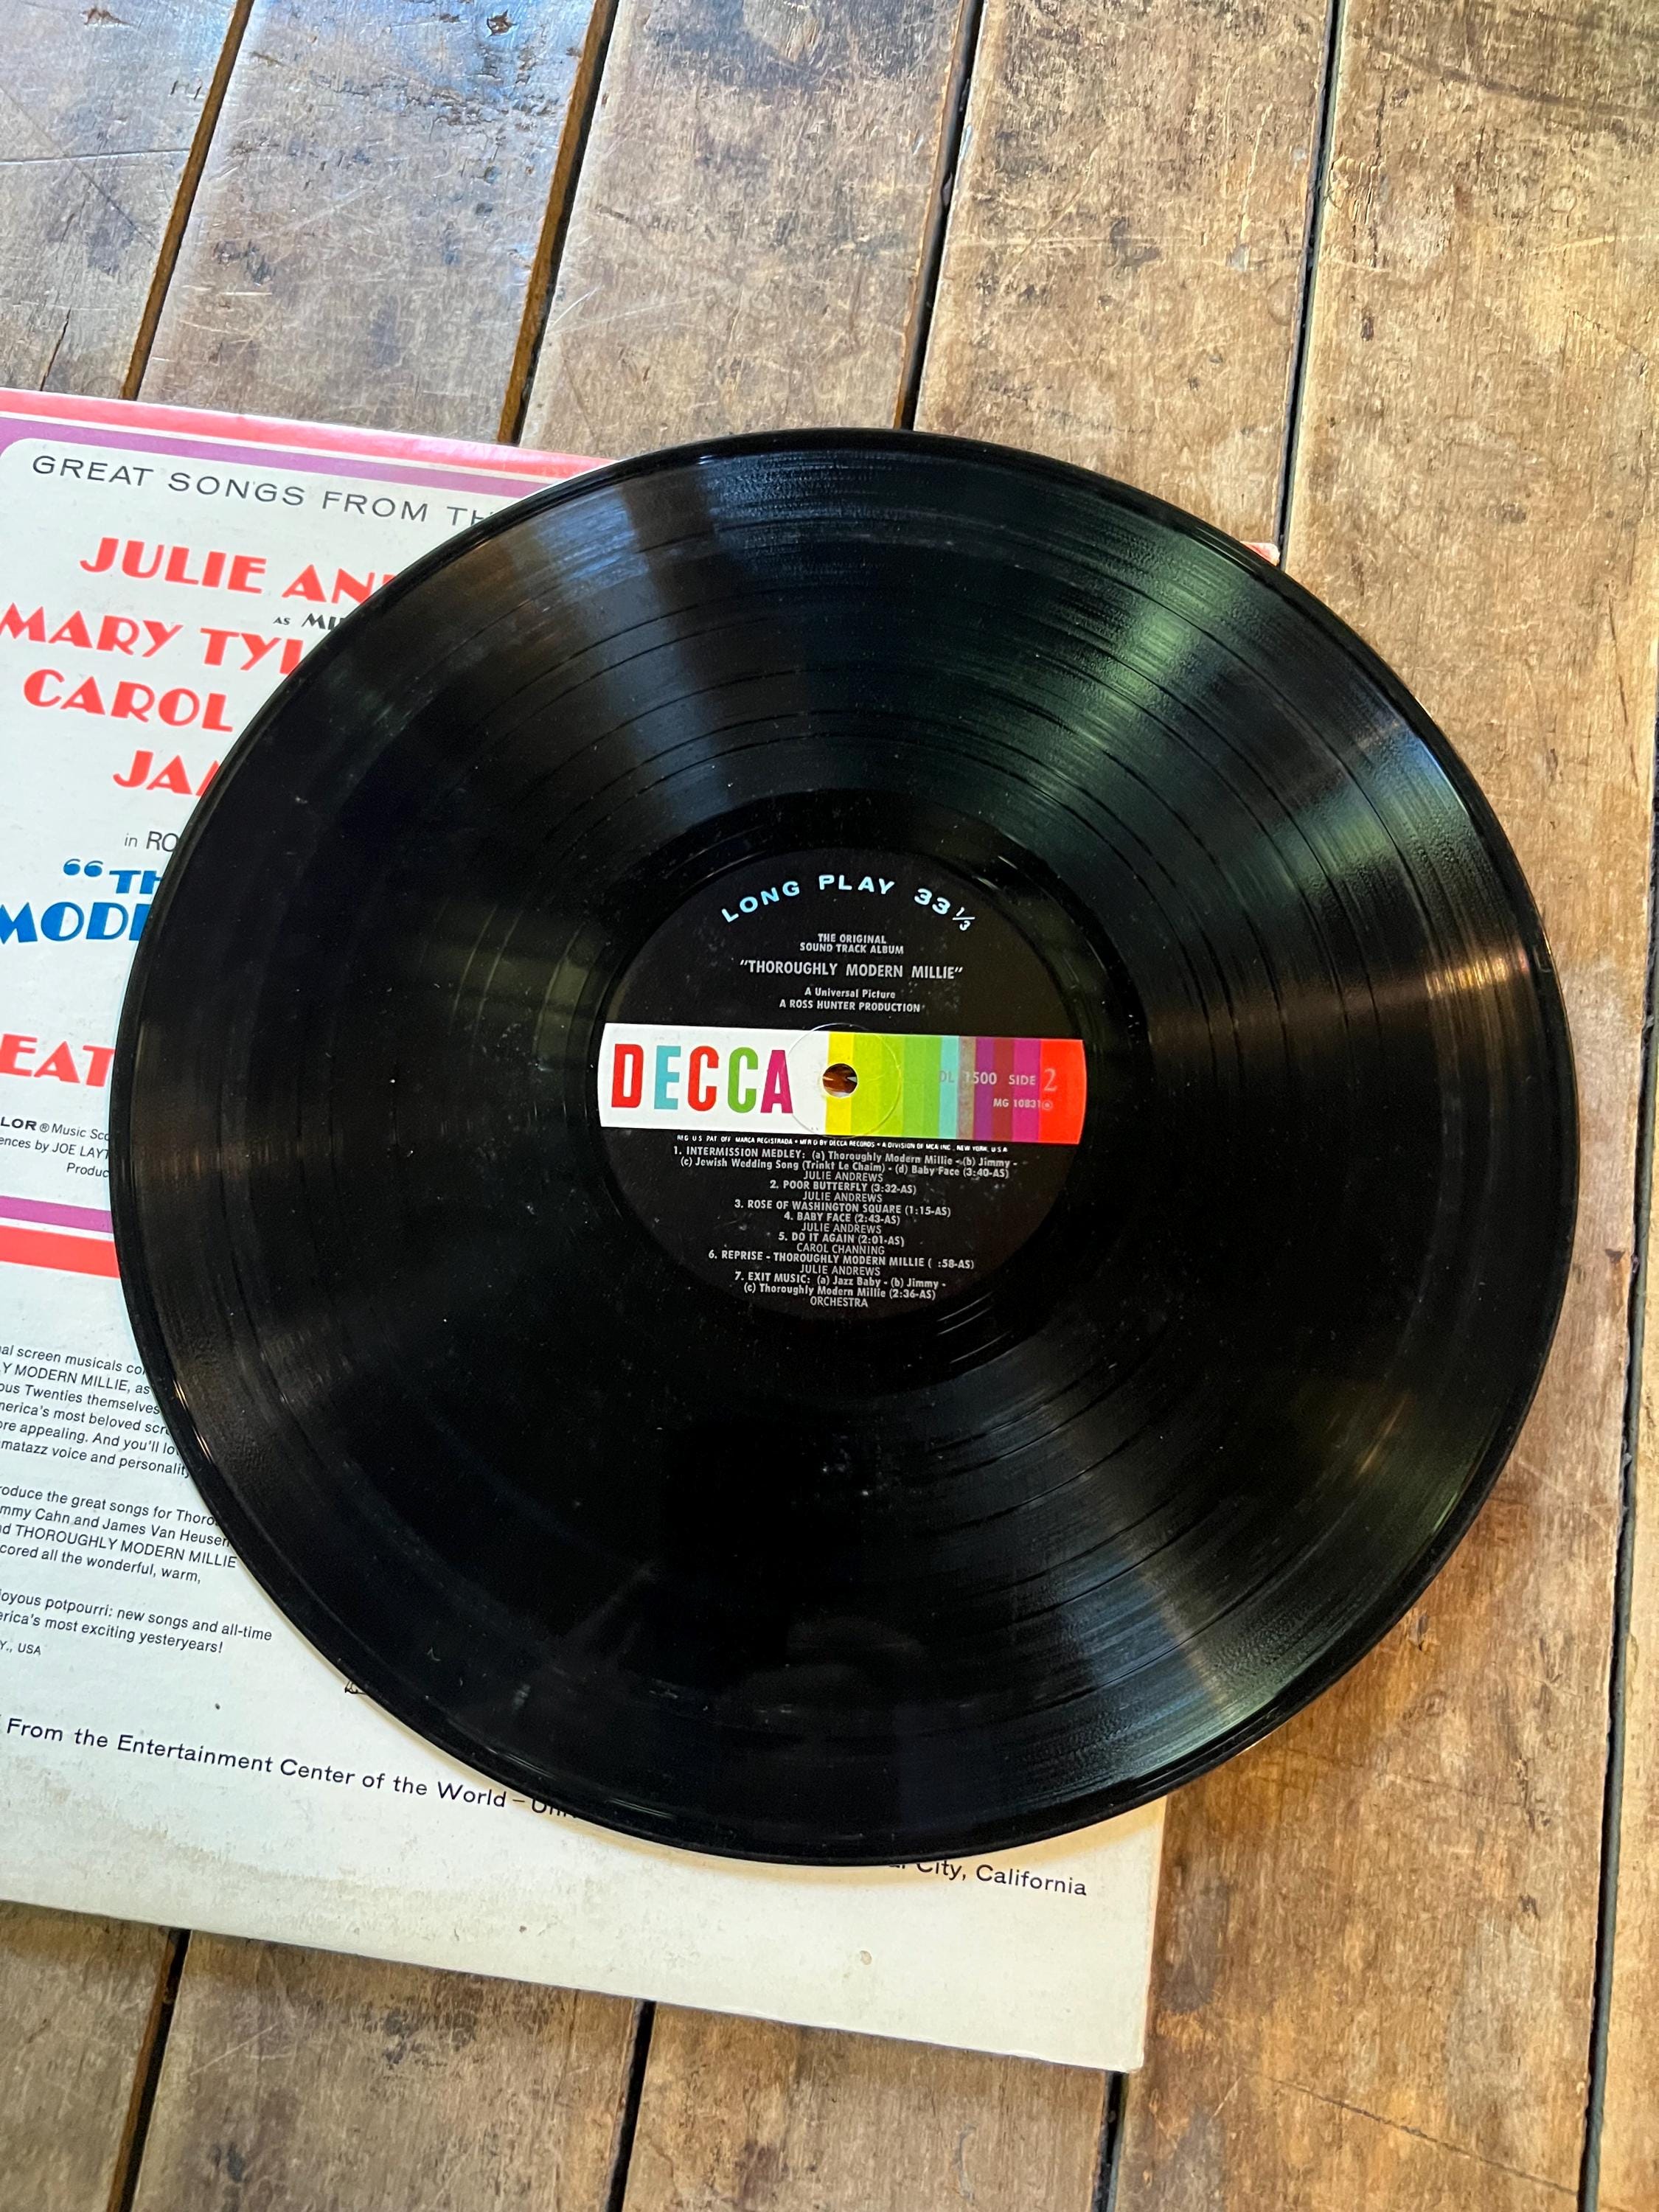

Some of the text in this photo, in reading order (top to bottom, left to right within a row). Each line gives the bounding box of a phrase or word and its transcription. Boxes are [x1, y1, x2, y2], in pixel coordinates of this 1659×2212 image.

[31, 454, 428, 523] GREAT SONGS FROM
[80, 537, 267, 594] JULIE
[0, 602, 184, 657] MARY
[273, 617, 290, 625] AS
[24, 669, 233, 732] CAROL
[124, 833, 137, 847] in
[722, 874, 894, 922] LONG PLAY
[800, 942, 904, 955] SOUND TRACK ALBUM
[818, 933, 886, 945] THE ORIGINAL
[846, 964, 903, 978] MODERN
[804, 987, 895, 999] A Universal Picture
[779, 999, 920, 1012] A ROSS HUNTER PRODUCTION
[611, 1043, 793, 1114] DECCA
[1009, 1068, 1057, 1091] SIDE 2
[993, 1099, 1009, 1107] MG
[52, 1124, 86, 1137] Music
[35, 1140, 77, 1155] by JOE
[681, 1157, 692, 1168] (c)
[695, 1157, 728, 1166] Jewish
[731, 1158, 772, 1170] Wedding
[776, 1160, 799, 1170] Song
[852, 1162, 885, 1172] Chaim)
[895, 1164, 908, 1175] (d)
[911, 1165, 939, 1176] Baby
[939, 1166, 959, 1176] Face
[686, 1146, 1010, 1169] INTERMISSION MEDLEY: (a) Thoroughly Modern Millie (b) Jimmy
[804, 1171, 883, 1183] JULIE ANDREWS
[770, 1180, 917, 1195] 2. POOR BUTTERFLY (3:32-AS)
[803, 1191, 883, 1203] JULIE ANDREWS
[734, 1199, 951, 1217] 3. ROSE OF WASHINGTON SQUARE (1:15-AS)
[785, 1211, 900, 1225] 4. BABY FACE (2:43-AS)
[801, 1222, 882, 1234] JULIE ANDREWS
[778, 1232, 905, 1247] 5. DO IT AGAIN (2:01-AS)
[797, 1242, 885, 1254] CAROL CHANNING
[709, 1250, 925, 1267] 6. REPRISE THOROUGHLY MODERN MILLIE
[800, 1265, 880, 1276] JULIE ANDREWS
[734, 1271, 939, 1290] 7. EXIT MUSIC: (a) Jazz Baby (b) Jimmy
[744, 1282, 936, 1301] (c) Thoroughly Modern Millie (2:36-AS)
[810, 1296, 868, 1307] ORCHESTRA
[17, 1348, 122, 1371] screen musicals
[15, 1364, 77, 1384] MODERN
[81, 1374, 131, 1394] MILLIE,
[135, 1385, 150, 1394] as
[25, 1385, 161, 1414] Twenties themselves
[54, 1410, 142, 1430] most beloved
[20, 1422, 159, 1453] appealing. And you'll
[52, 1447, 116, 1465] voice and
[47, 1491, 172, 1519] the great songs for
[35, 1508, 230, 1547] Cahn and James Van Heusen
[15, 1525, 118, 1550] THOROUGHLY
[120, 1540, 185, 1560] MODERN
[189, 1551, 237, 1568] MILLIE
[41, 1550, 201, 1585] all the wonderful, warm,
[45, 1599, 272, 1641] potpourri: new songs and all-time
[45, 1618, 223, 1653] most exciting yesteryears!
[18, 1643, 41, 1655] USA
[7, 1717, 507, 1807] From the Entertainment Center of the World
[976, 1864, 1087, 1896] California
